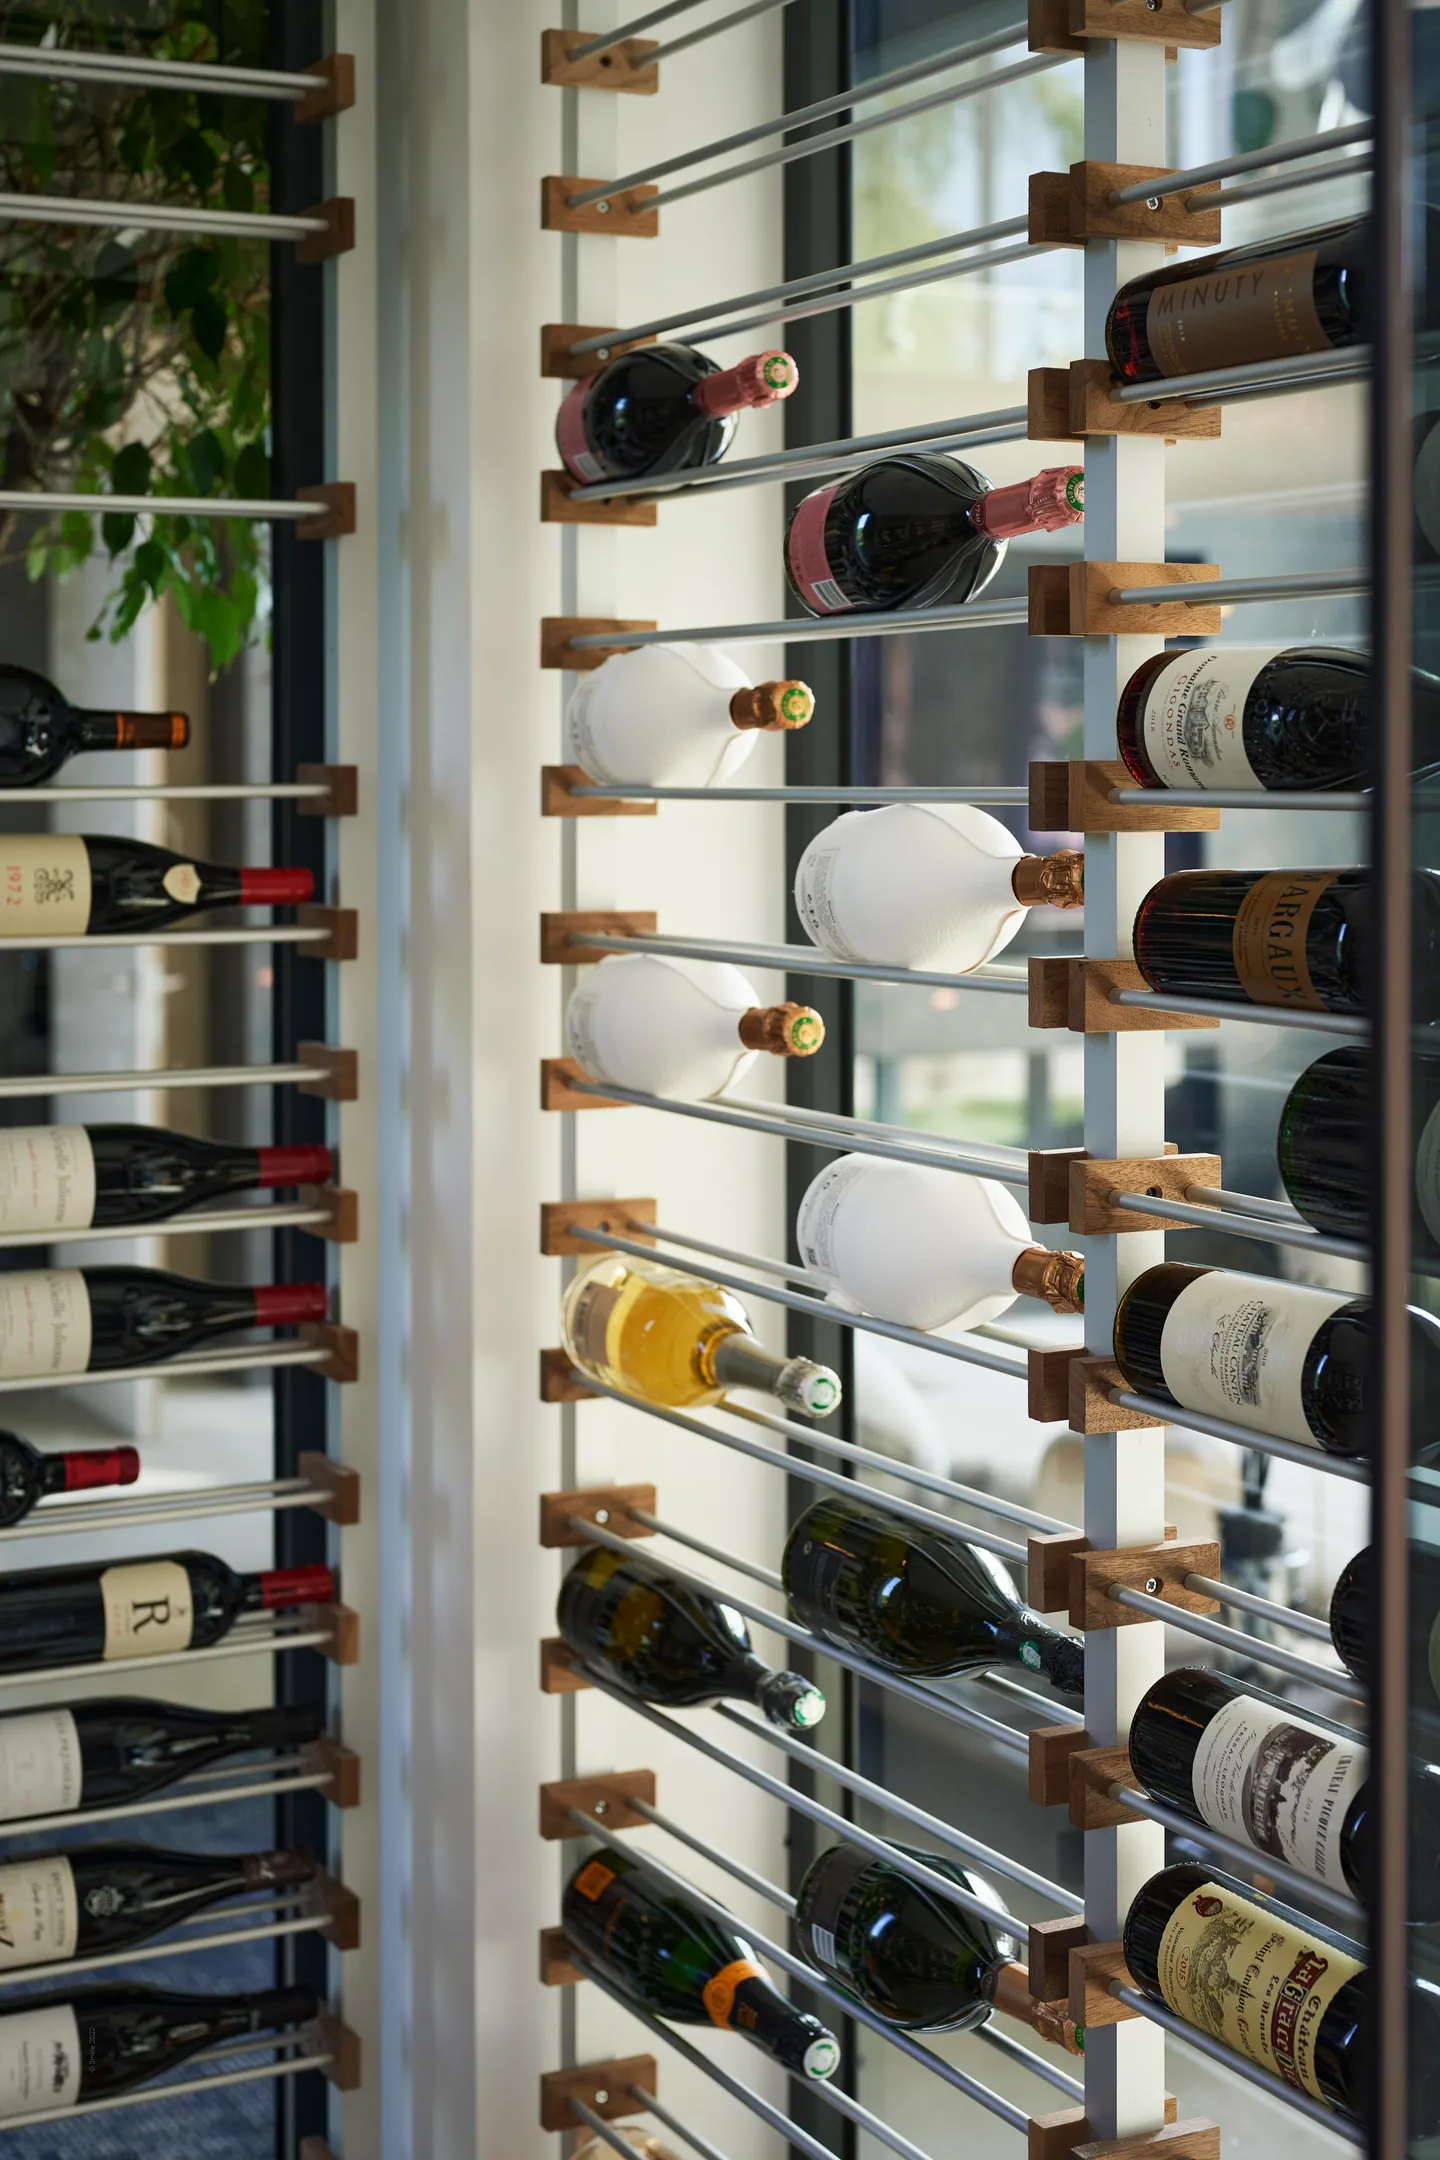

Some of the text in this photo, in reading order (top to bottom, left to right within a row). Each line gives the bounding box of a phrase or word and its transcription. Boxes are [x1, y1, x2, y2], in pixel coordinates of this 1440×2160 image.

[1157, 269, 1265, 318] MINUTY
[1181, 654, 1218, 699] Domaine
[1166, 674, 1189, 768] GIGONDAS
[1176, 703, 1187, 745] Grand
[5, 865, 23, 906] 1972
[1267, 870, 1325, 1001] MARGAUX
[1261, 1347, 1270, 1367] 2018
[1225, 1387, 1234, 1403] CRU
[1229, 1356, 1244, 1406] CANTIN
[131, 1594, 171, 1637] R
[1179, 1953, 1189, 1981] 2015
[1258, 1932, 1286, 1963] Saint
[1298, 1995, 1322, 2080] Château
